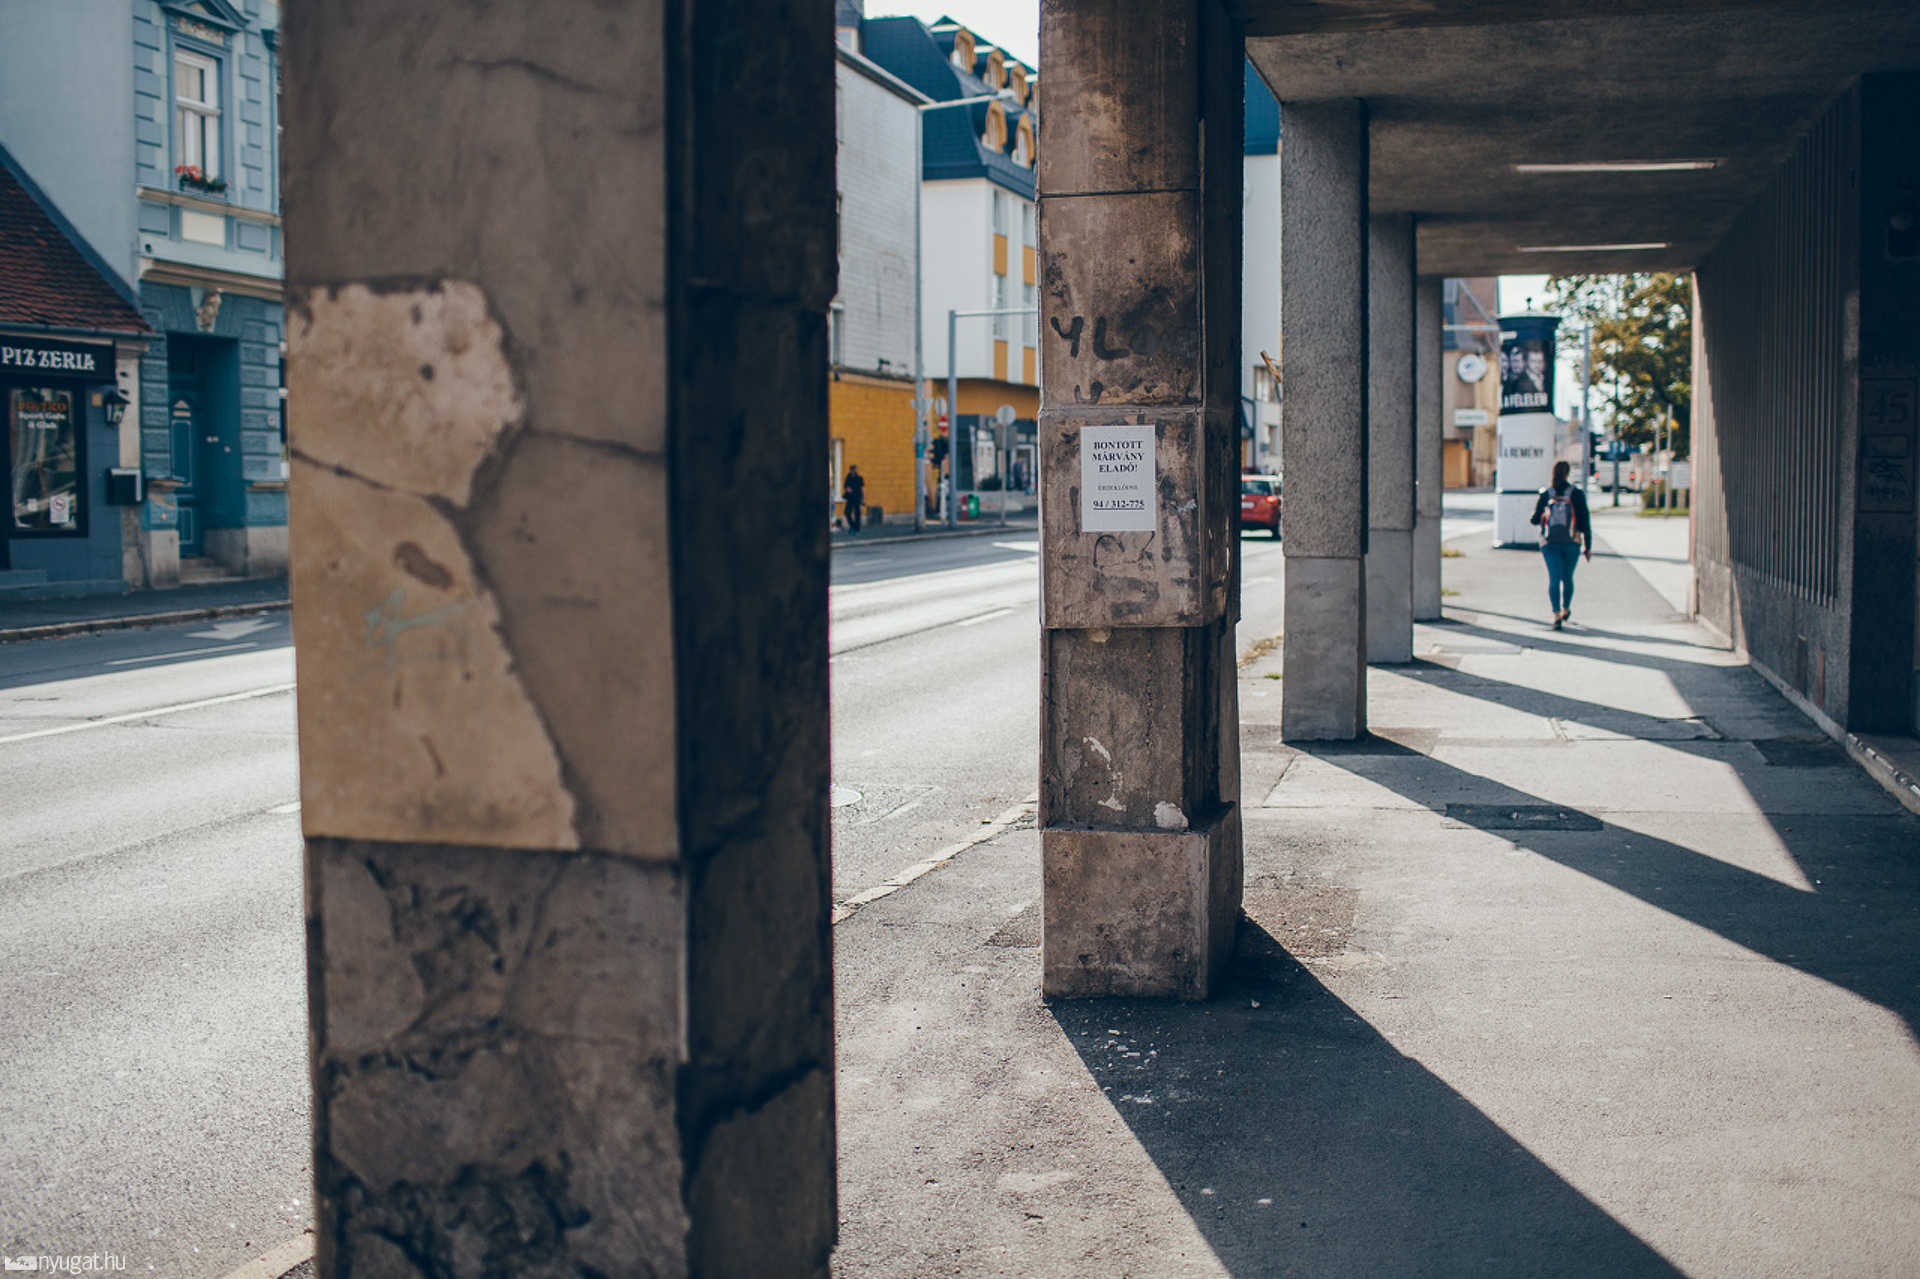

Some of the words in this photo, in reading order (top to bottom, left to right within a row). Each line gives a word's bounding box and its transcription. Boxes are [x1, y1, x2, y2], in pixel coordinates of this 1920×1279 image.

[1, 346, 96, 371] PIZZERIA
[1093, 440, 1144, 449] BONTOTT
[1092, 451, 1144, 460] MÁRVÁNY
